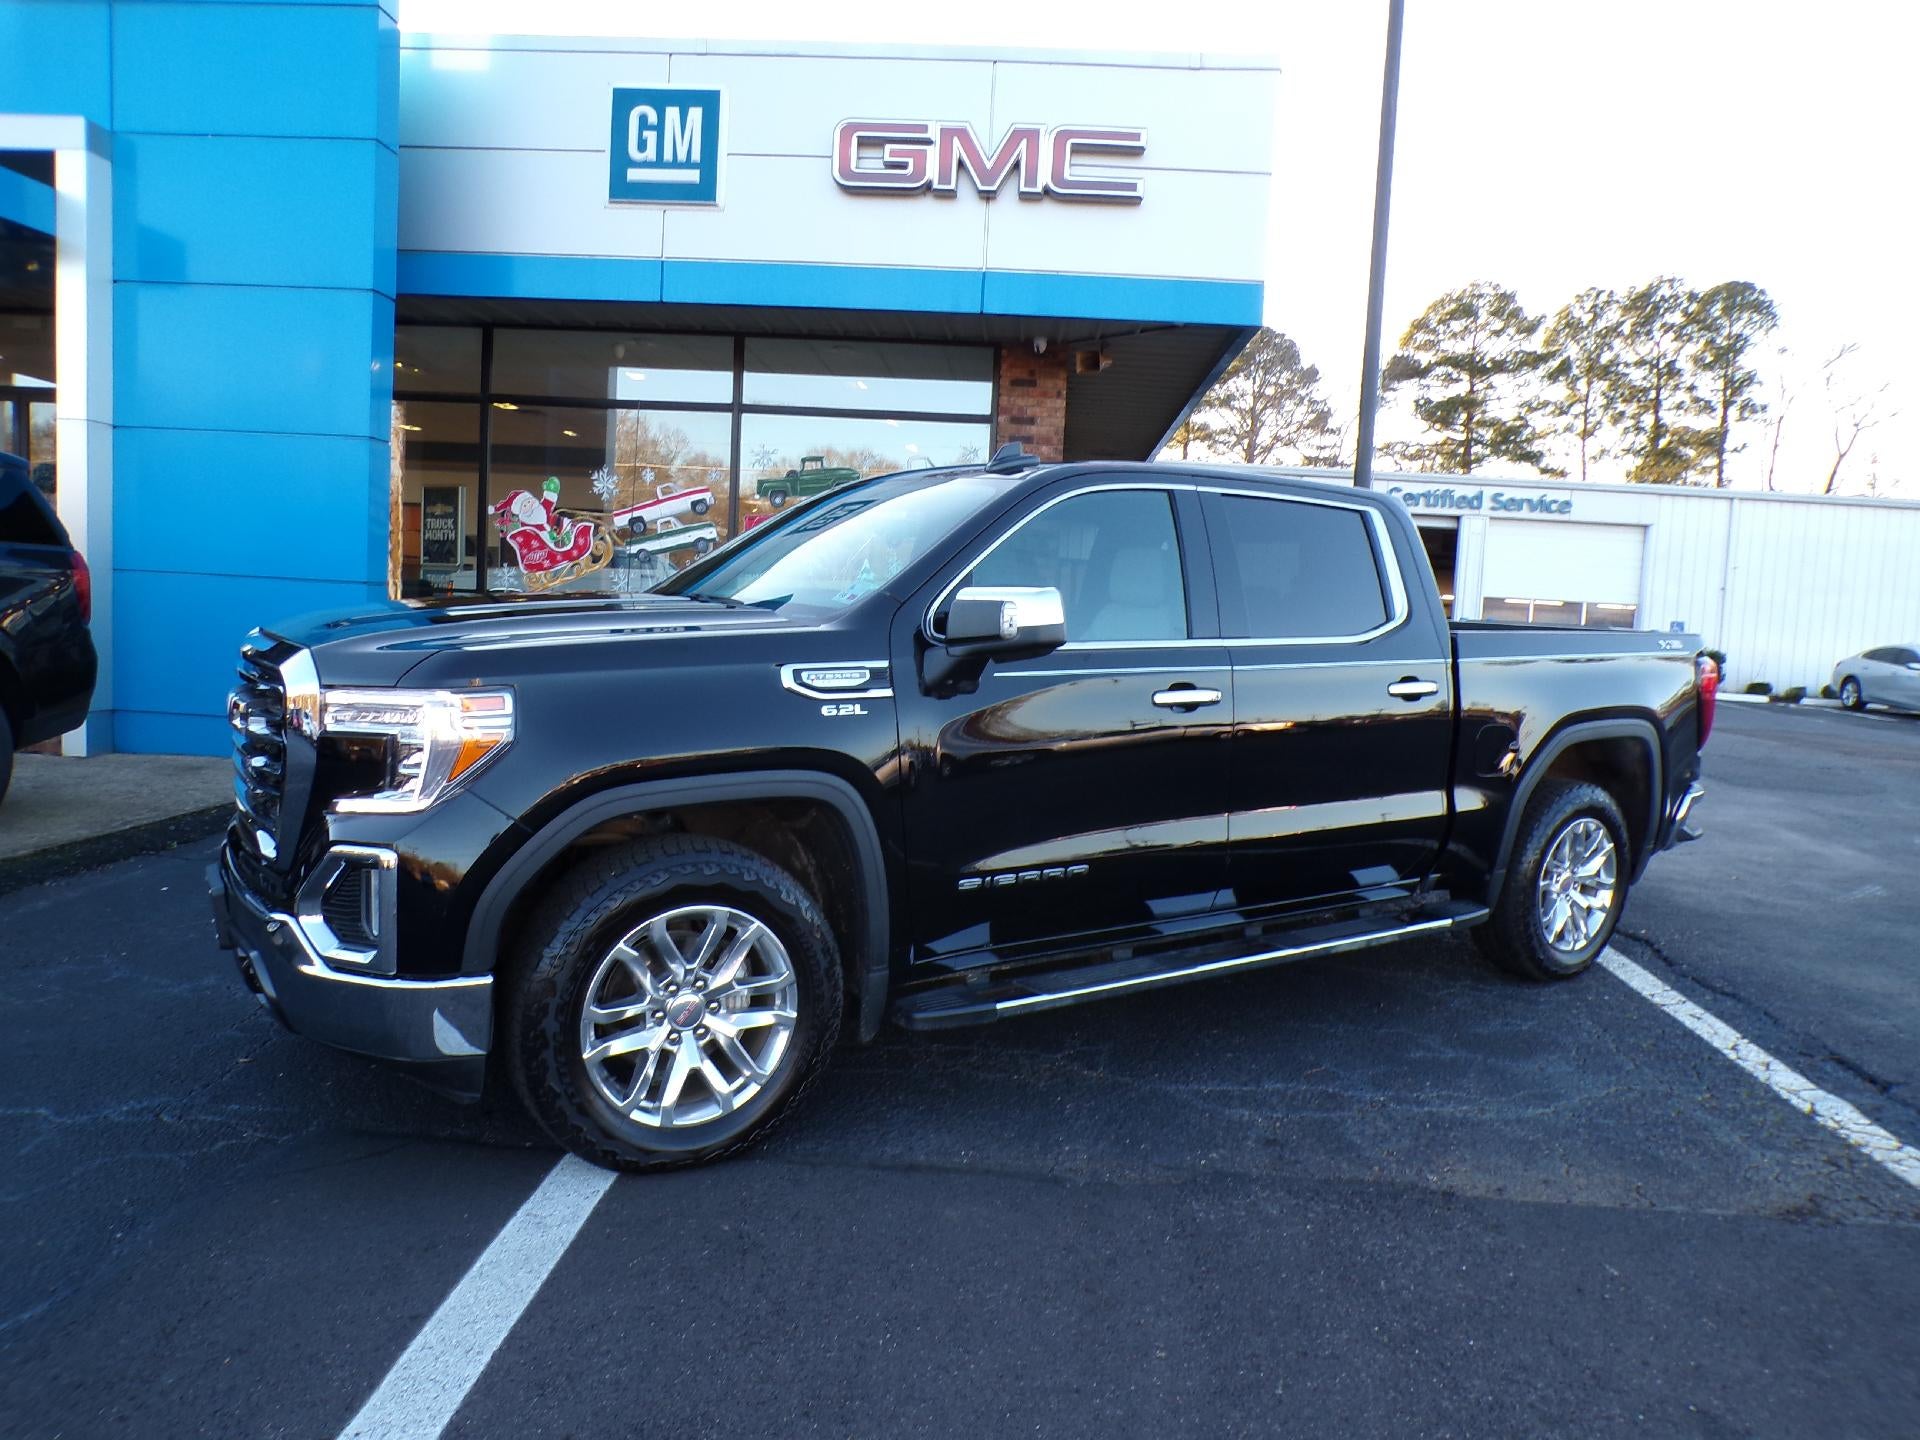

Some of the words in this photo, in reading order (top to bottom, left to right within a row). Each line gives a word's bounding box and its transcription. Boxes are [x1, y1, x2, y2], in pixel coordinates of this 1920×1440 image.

[627, 105, 703, 164] GM
[831, 117, 1148, 206] GMC
[1489, 492, 1573, 515] Service
[424, 529, 456, 541] MONTH
[425, 518, 455, 530] TRUCK
